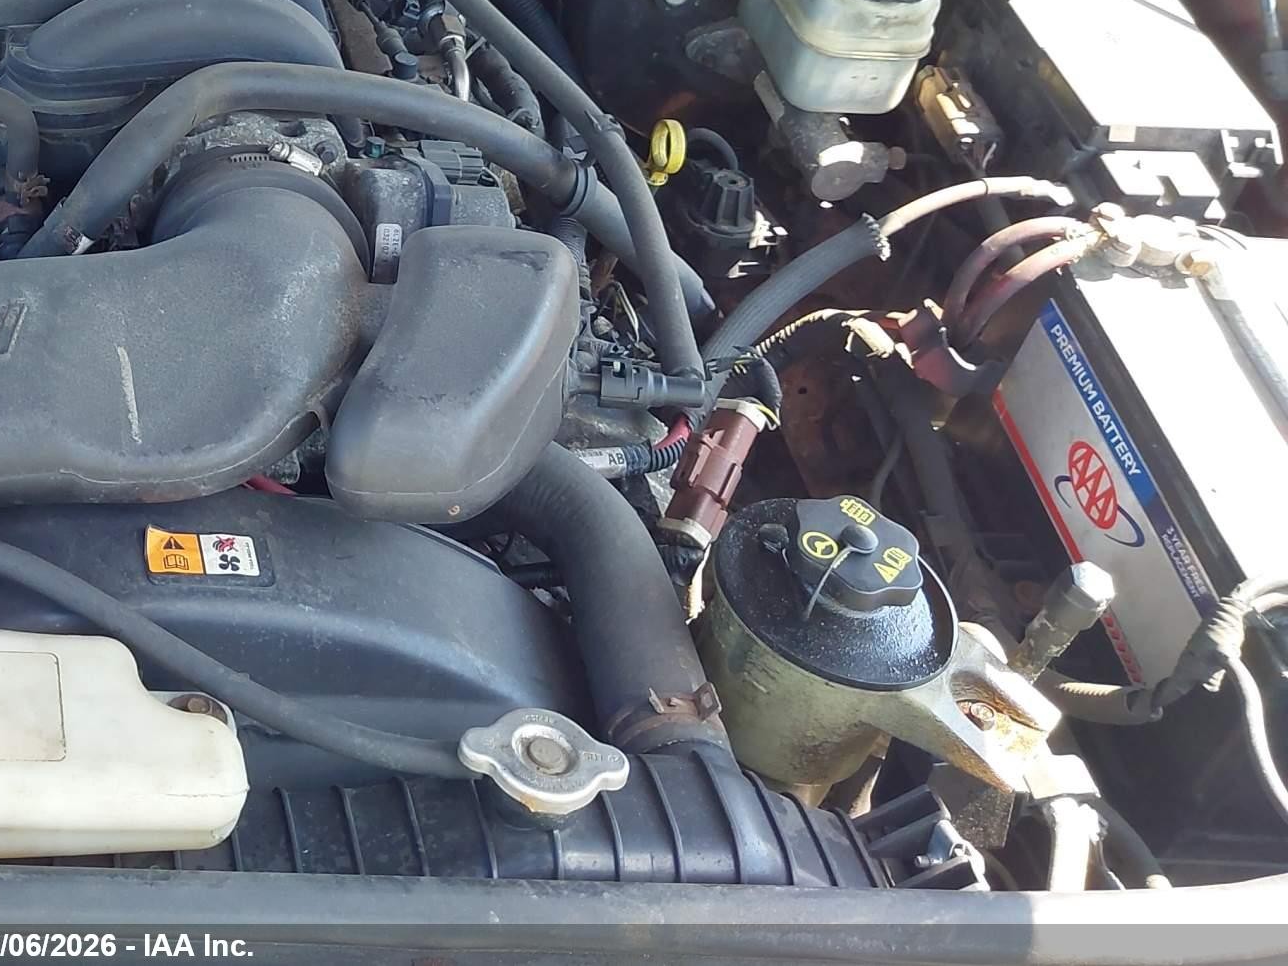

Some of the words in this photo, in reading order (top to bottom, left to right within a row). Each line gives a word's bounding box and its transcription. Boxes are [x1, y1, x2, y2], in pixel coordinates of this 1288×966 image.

[1050, 323, 1098, 401] PREMIUM
[1092, 400, 1142, 476] BATTERY
[608, 452, 624, 465] AB
[1069, 442, 1117, 528] AAA
[1161, 533, 1200, 598] REPLACEMENT
[1166, 525, 1175, 535] 3
[1171, 534, 1191, 564] YEAR
[1187, 564, 1208, 594] FREE
